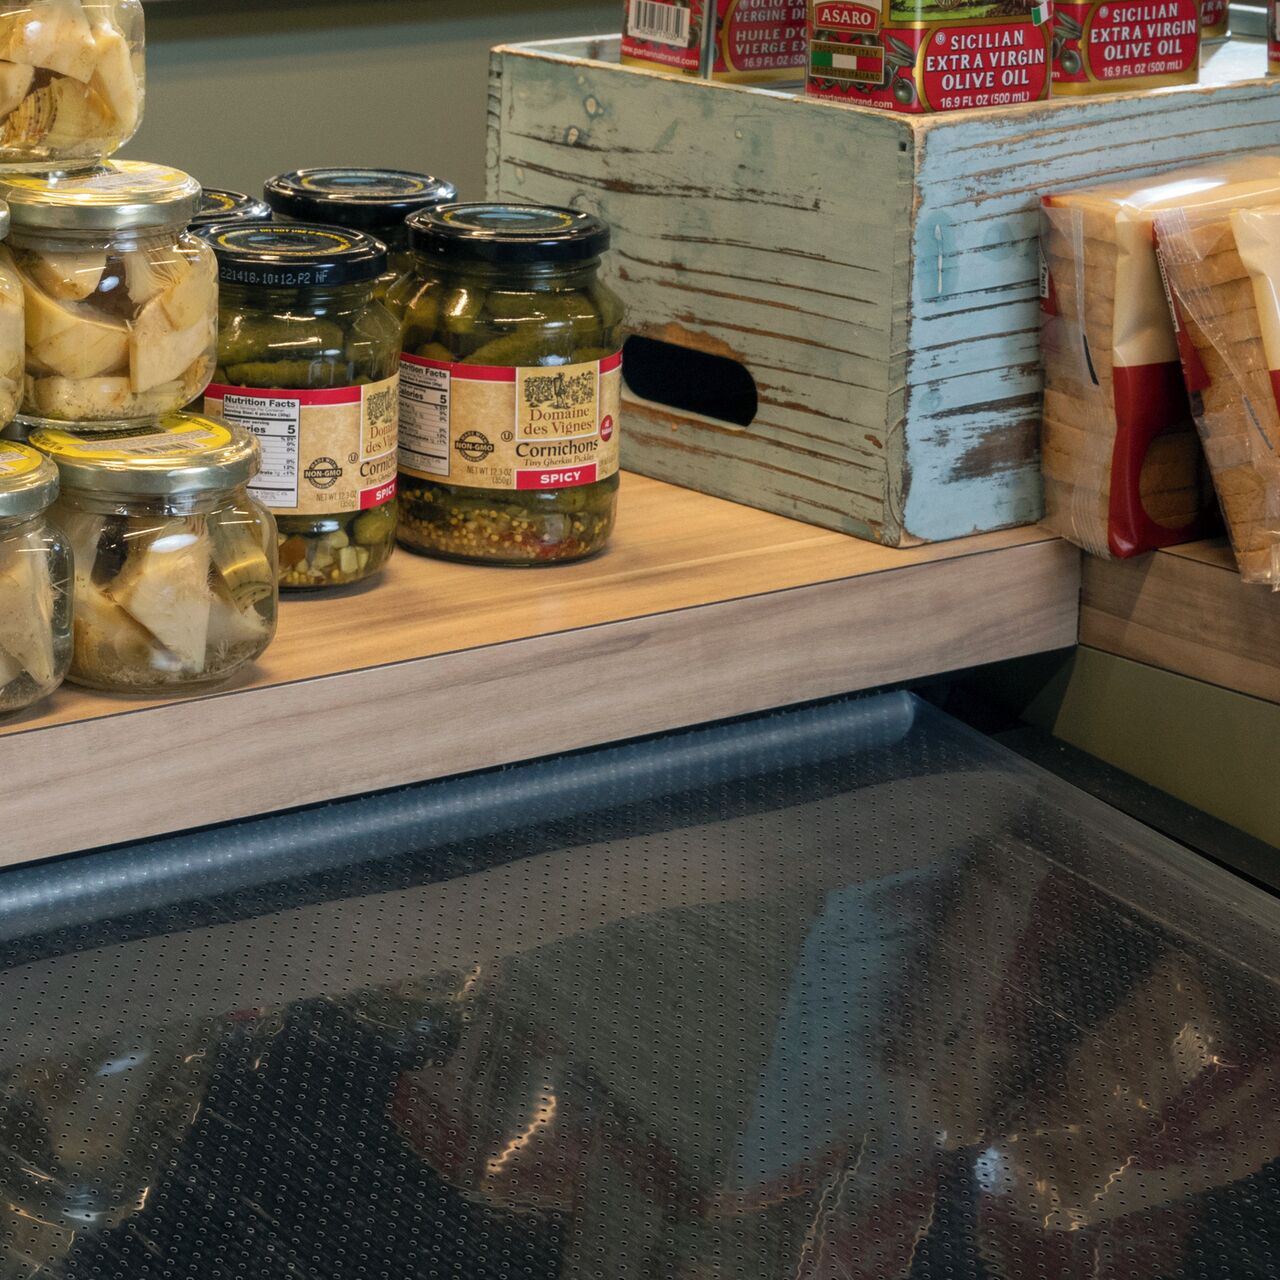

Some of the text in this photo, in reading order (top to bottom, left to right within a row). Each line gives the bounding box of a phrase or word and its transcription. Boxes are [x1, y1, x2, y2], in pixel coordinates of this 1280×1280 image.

[821, 10, 872, 25] ASARO
[1113, 2, 1178, 23] SICILIAN
[951, 30, 1024, 51] SICILIAN
[1091, 20, 1196, 44] EXTRA VIRGIN
[1104, 40, 1183, 61] OLIVE OIL
[926, 48, 1044, 72] EXTRA VIRGIN
[942, 69, 1030, 91] OLIVE OIL
[224, 396, 296, 408] Nutrition Facts
[530, 407, 590, 421] Domaine
[524, 422, 591, 435] des Vignes
[455, 443, 493, 452] NON-GMO
[516, 439, 598, 458] Cornichons
[304, 469, 341, 478] NON-GMO
[540, 471, 581, 484] SPICY
